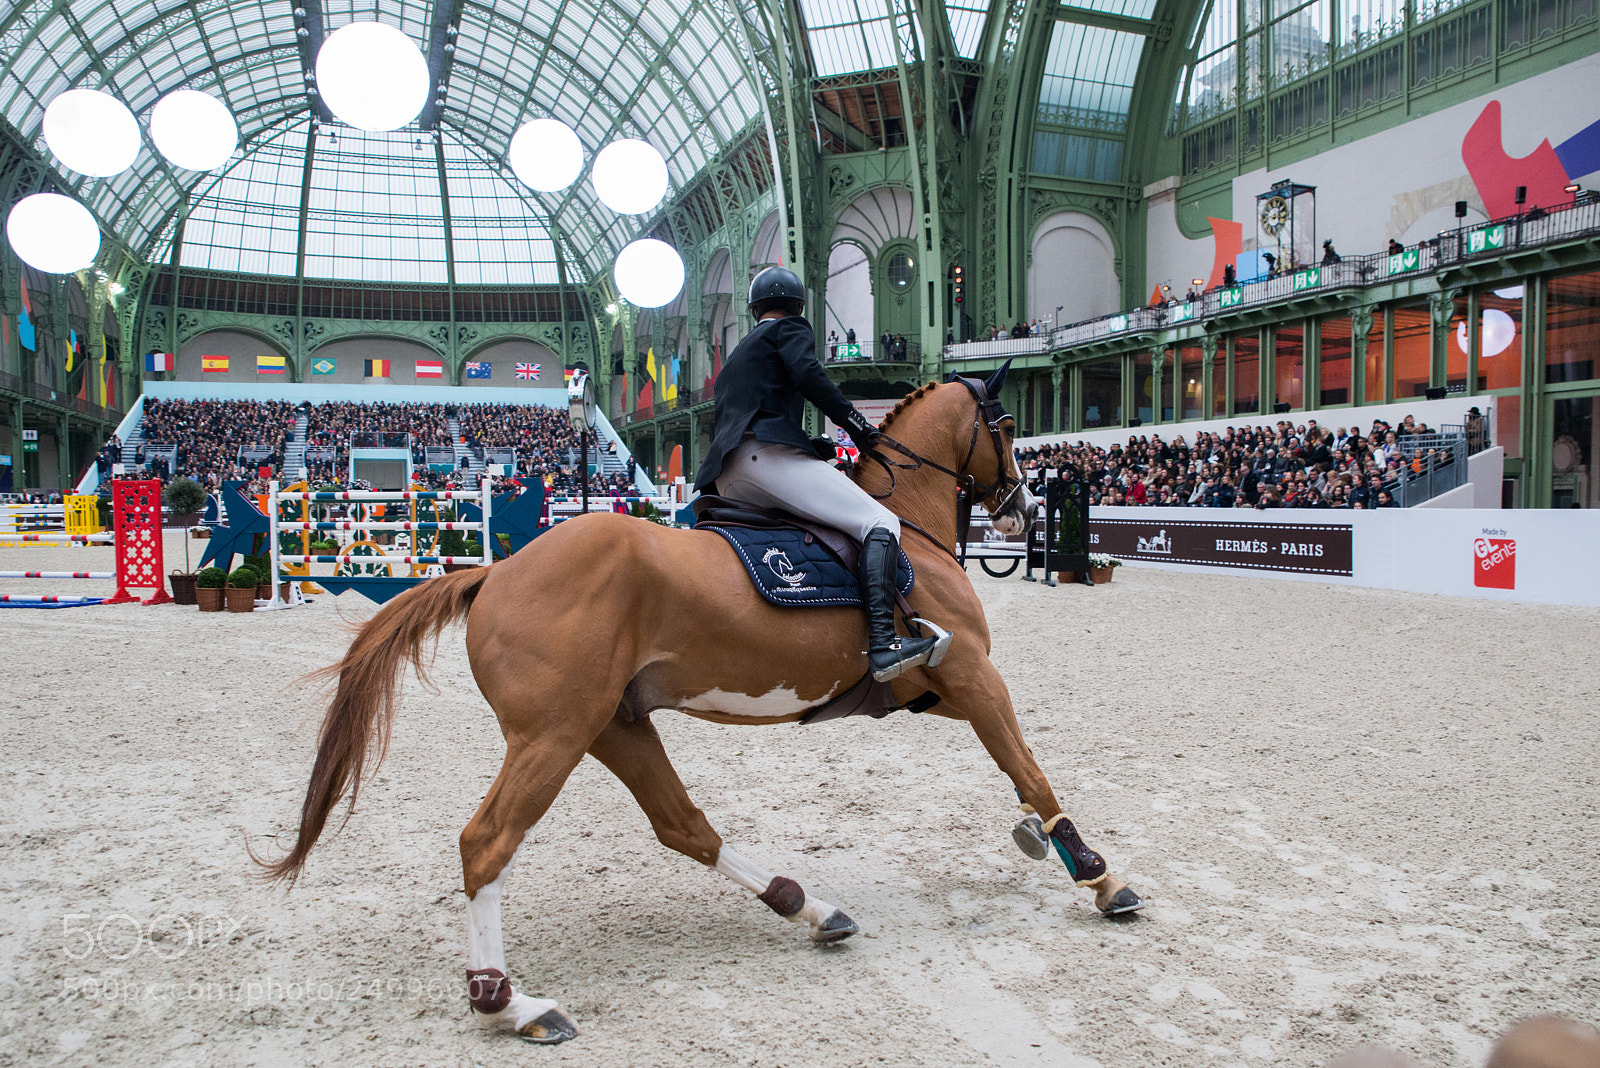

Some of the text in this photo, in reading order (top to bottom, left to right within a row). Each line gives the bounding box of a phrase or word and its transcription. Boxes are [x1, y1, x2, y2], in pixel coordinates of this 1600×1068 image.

[1500, 528, 1507, 537] by
[1215, 539, 1268, 554] HERMÈS
[1281, 542, 1324, 557] PARIS
[1475, 539, 1499, 558] GL
[1481, 542, 1517, 571] events
